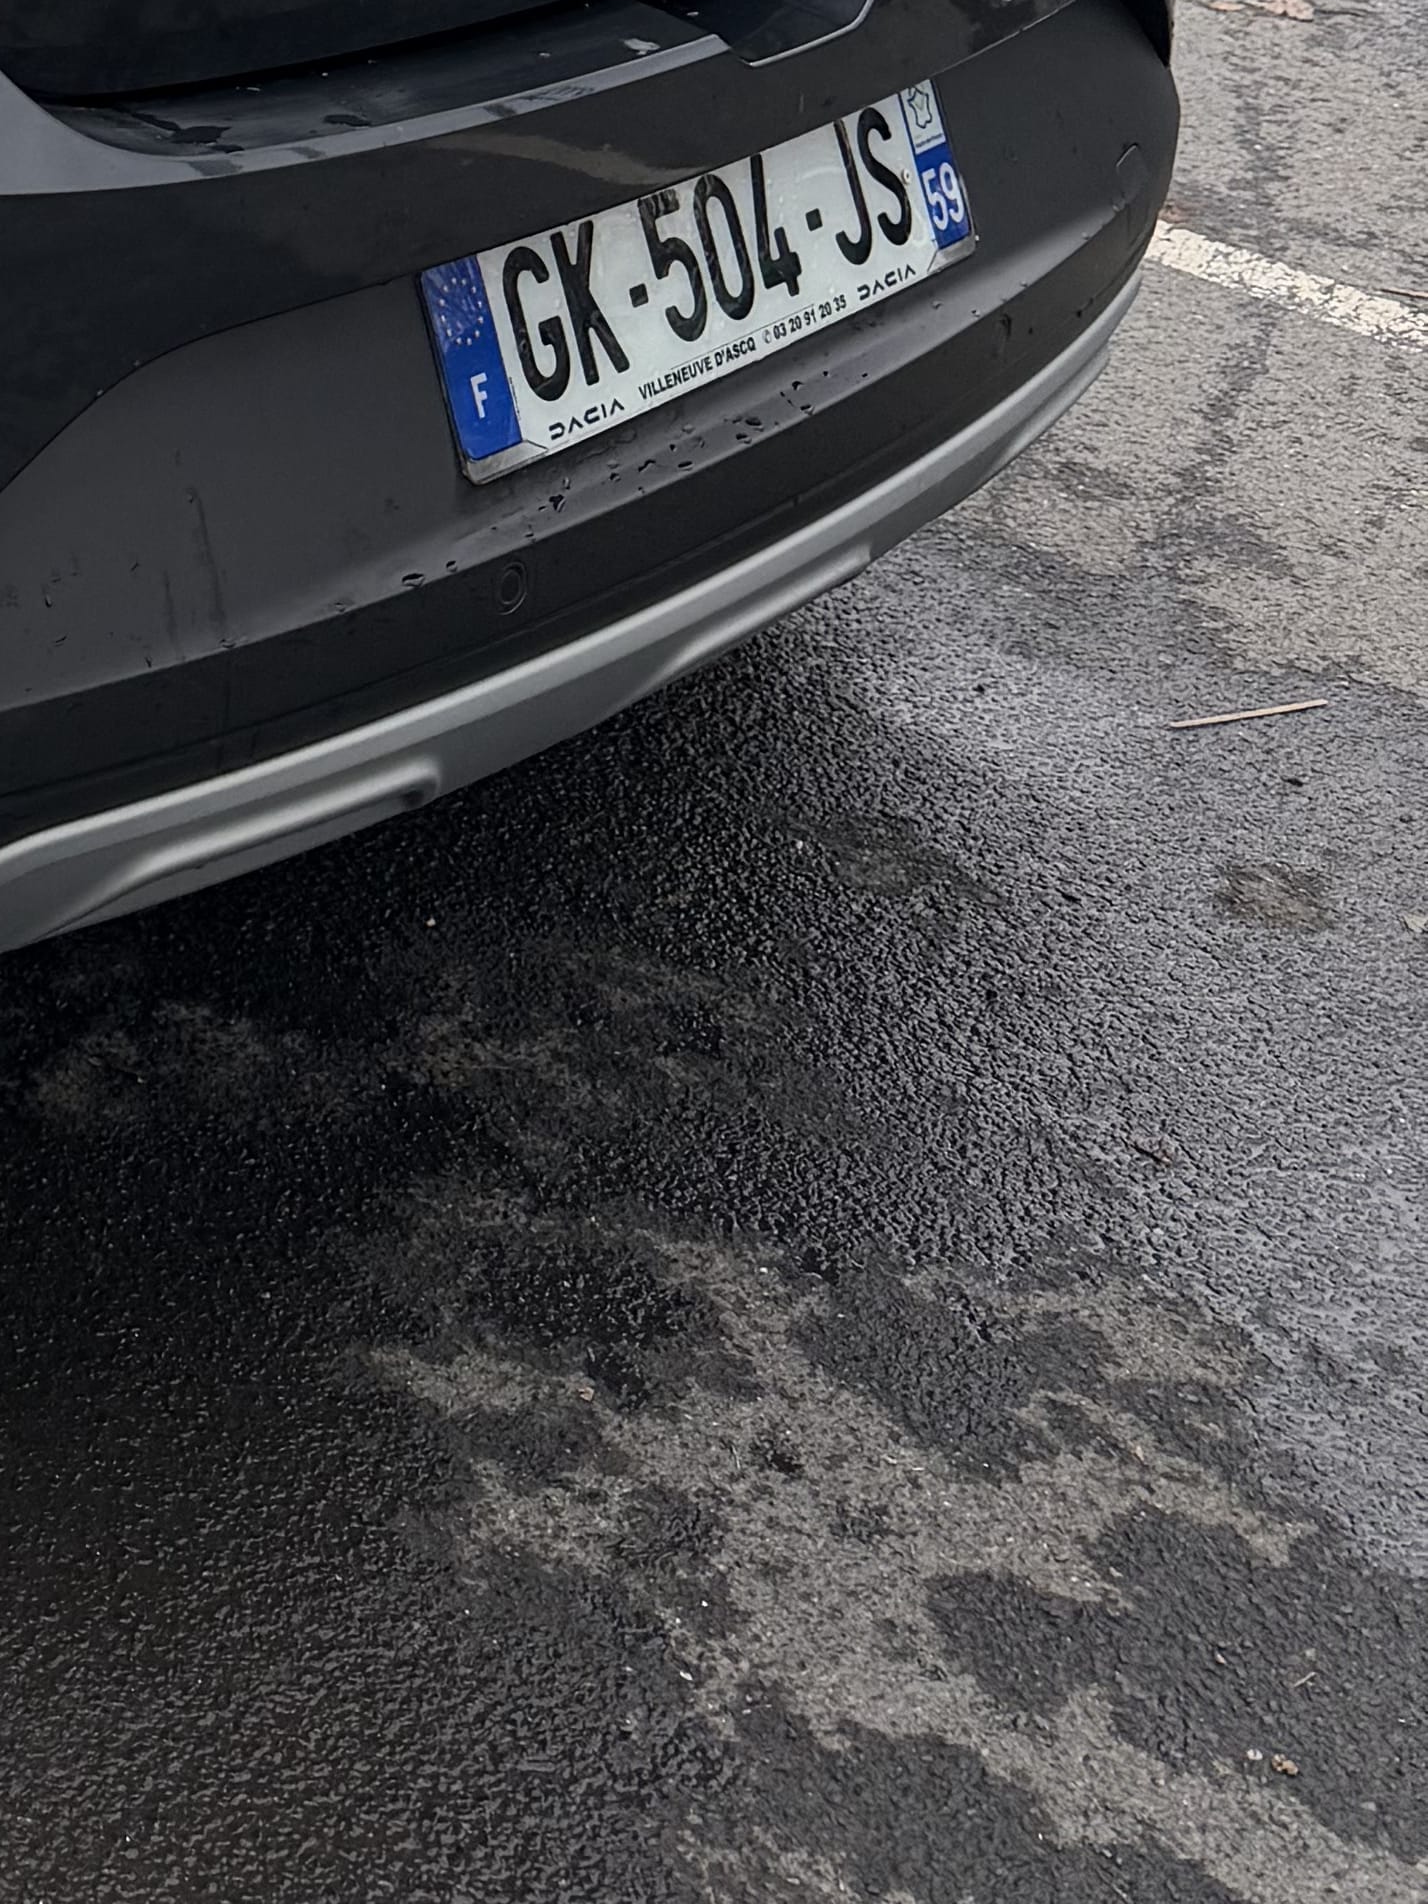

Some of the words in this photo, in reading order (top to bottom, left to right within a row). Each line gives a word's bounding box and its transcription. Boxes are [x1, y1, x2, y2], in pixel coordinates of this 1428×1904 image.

[501, 105, 915, 403] GK-504-JS
[921, 161, 965, 231] 59
[469, 371, 489, 420] F
[548, 397, 625, 440] DACIA
[638, 356, 714, 400] VILLENEUVE
[714, 335, 757, 368] D'ASCQ
[773, 324, 787, 339] 03
[789, 316, 802, 333] 20
[804, 310, 817, 326] 91
[819, 302, 832, 318] 20
[834, 295, 847, 312] 35
[857, 264, 916, 300] DACIA
